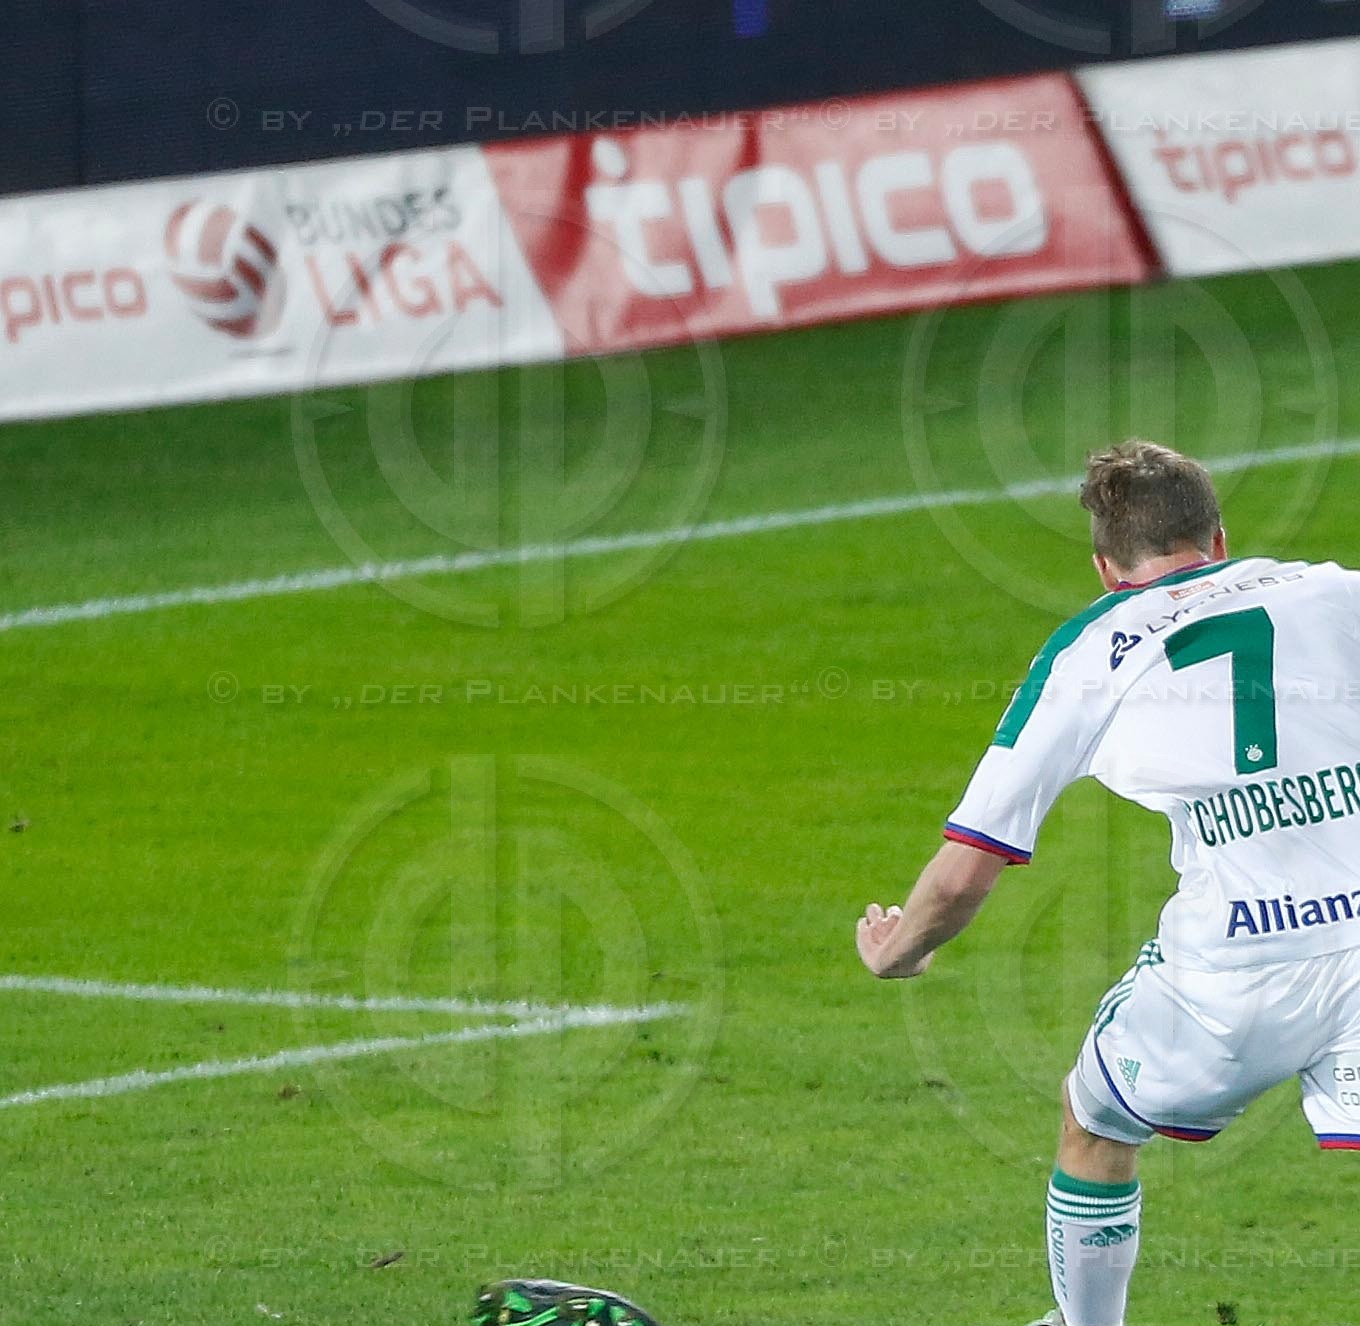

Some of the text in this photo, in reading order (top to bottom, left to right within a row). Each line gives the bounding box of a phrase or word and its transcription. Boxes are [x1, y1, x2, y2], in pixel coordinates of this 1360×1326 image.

[1153, 124, 1358, 204] tipico
[586, 137, 1048, 320] tipico
[0, 265, 148, 344] pico
[303, 240, 505, 328] LIGA
[1163, 606, 1277, 775] 7
